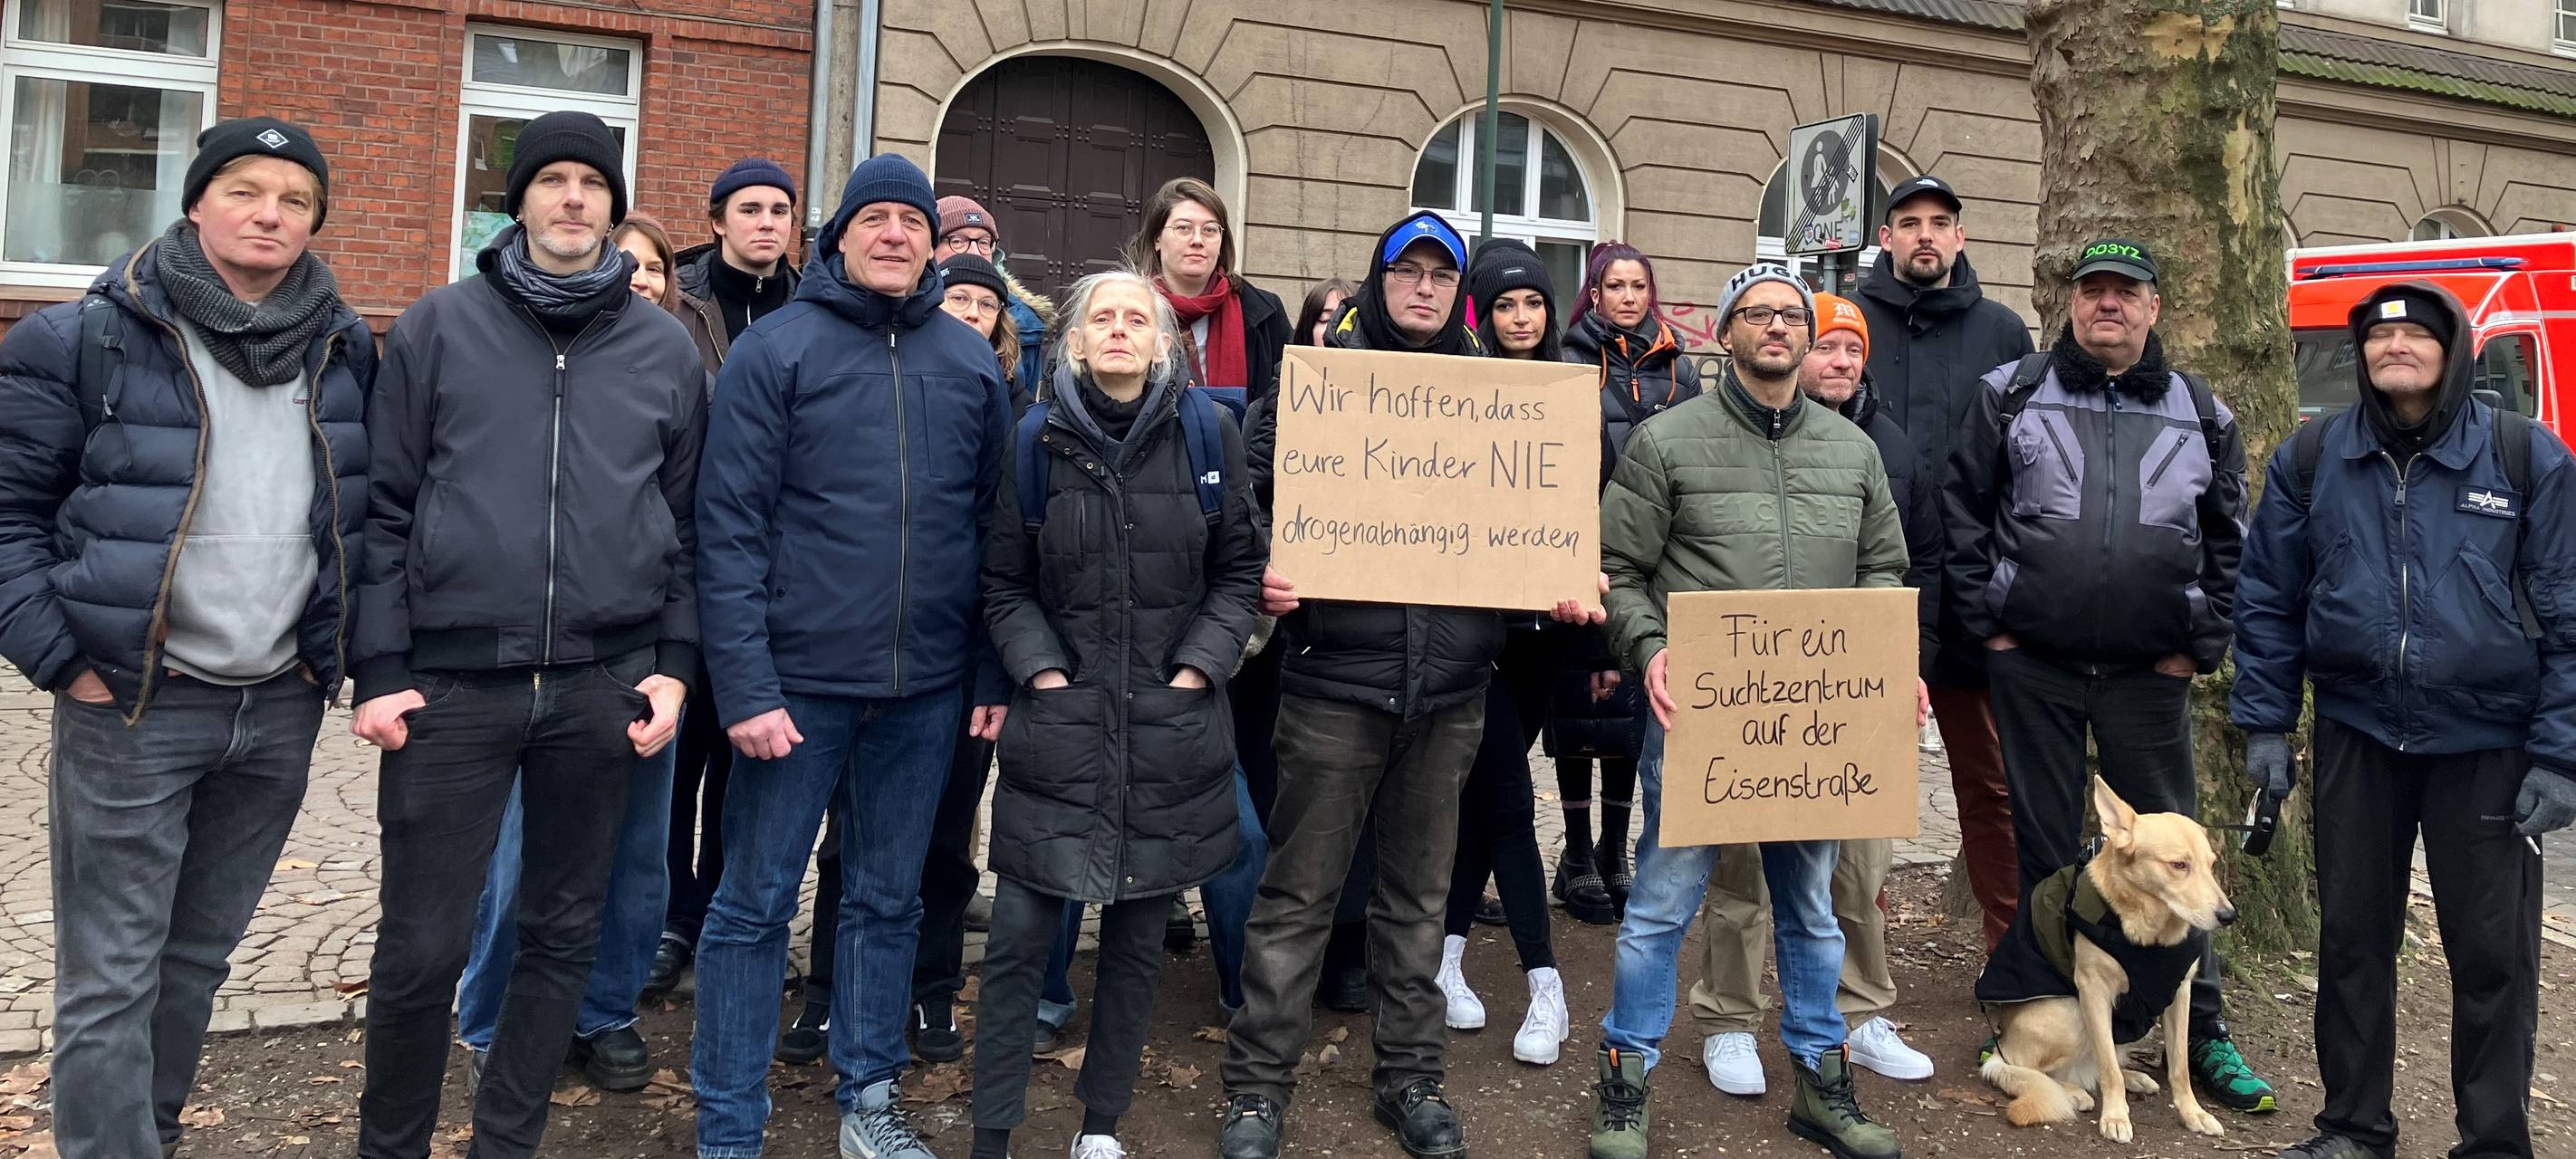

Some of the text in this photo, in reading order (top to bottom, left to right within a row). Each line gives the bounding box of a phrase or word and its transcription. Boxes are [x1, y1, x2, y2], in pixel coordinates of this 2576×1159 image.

[1803, 220, 1843, 244] ONE
[1732, 265, 1808, 292] HUGO
[1289, 361, 1545, 422] Wir hoffen, dass
[1283, 436, 1564, 489] eure Kinder NIE
[1282, 503, 1580, 557] drogenabhängig werden
[1720, 614, 1847, 657] Für ein
[1742, 710, 1847, 746] auf der
[1704, 757, 1879, 806] Eisenstraße
